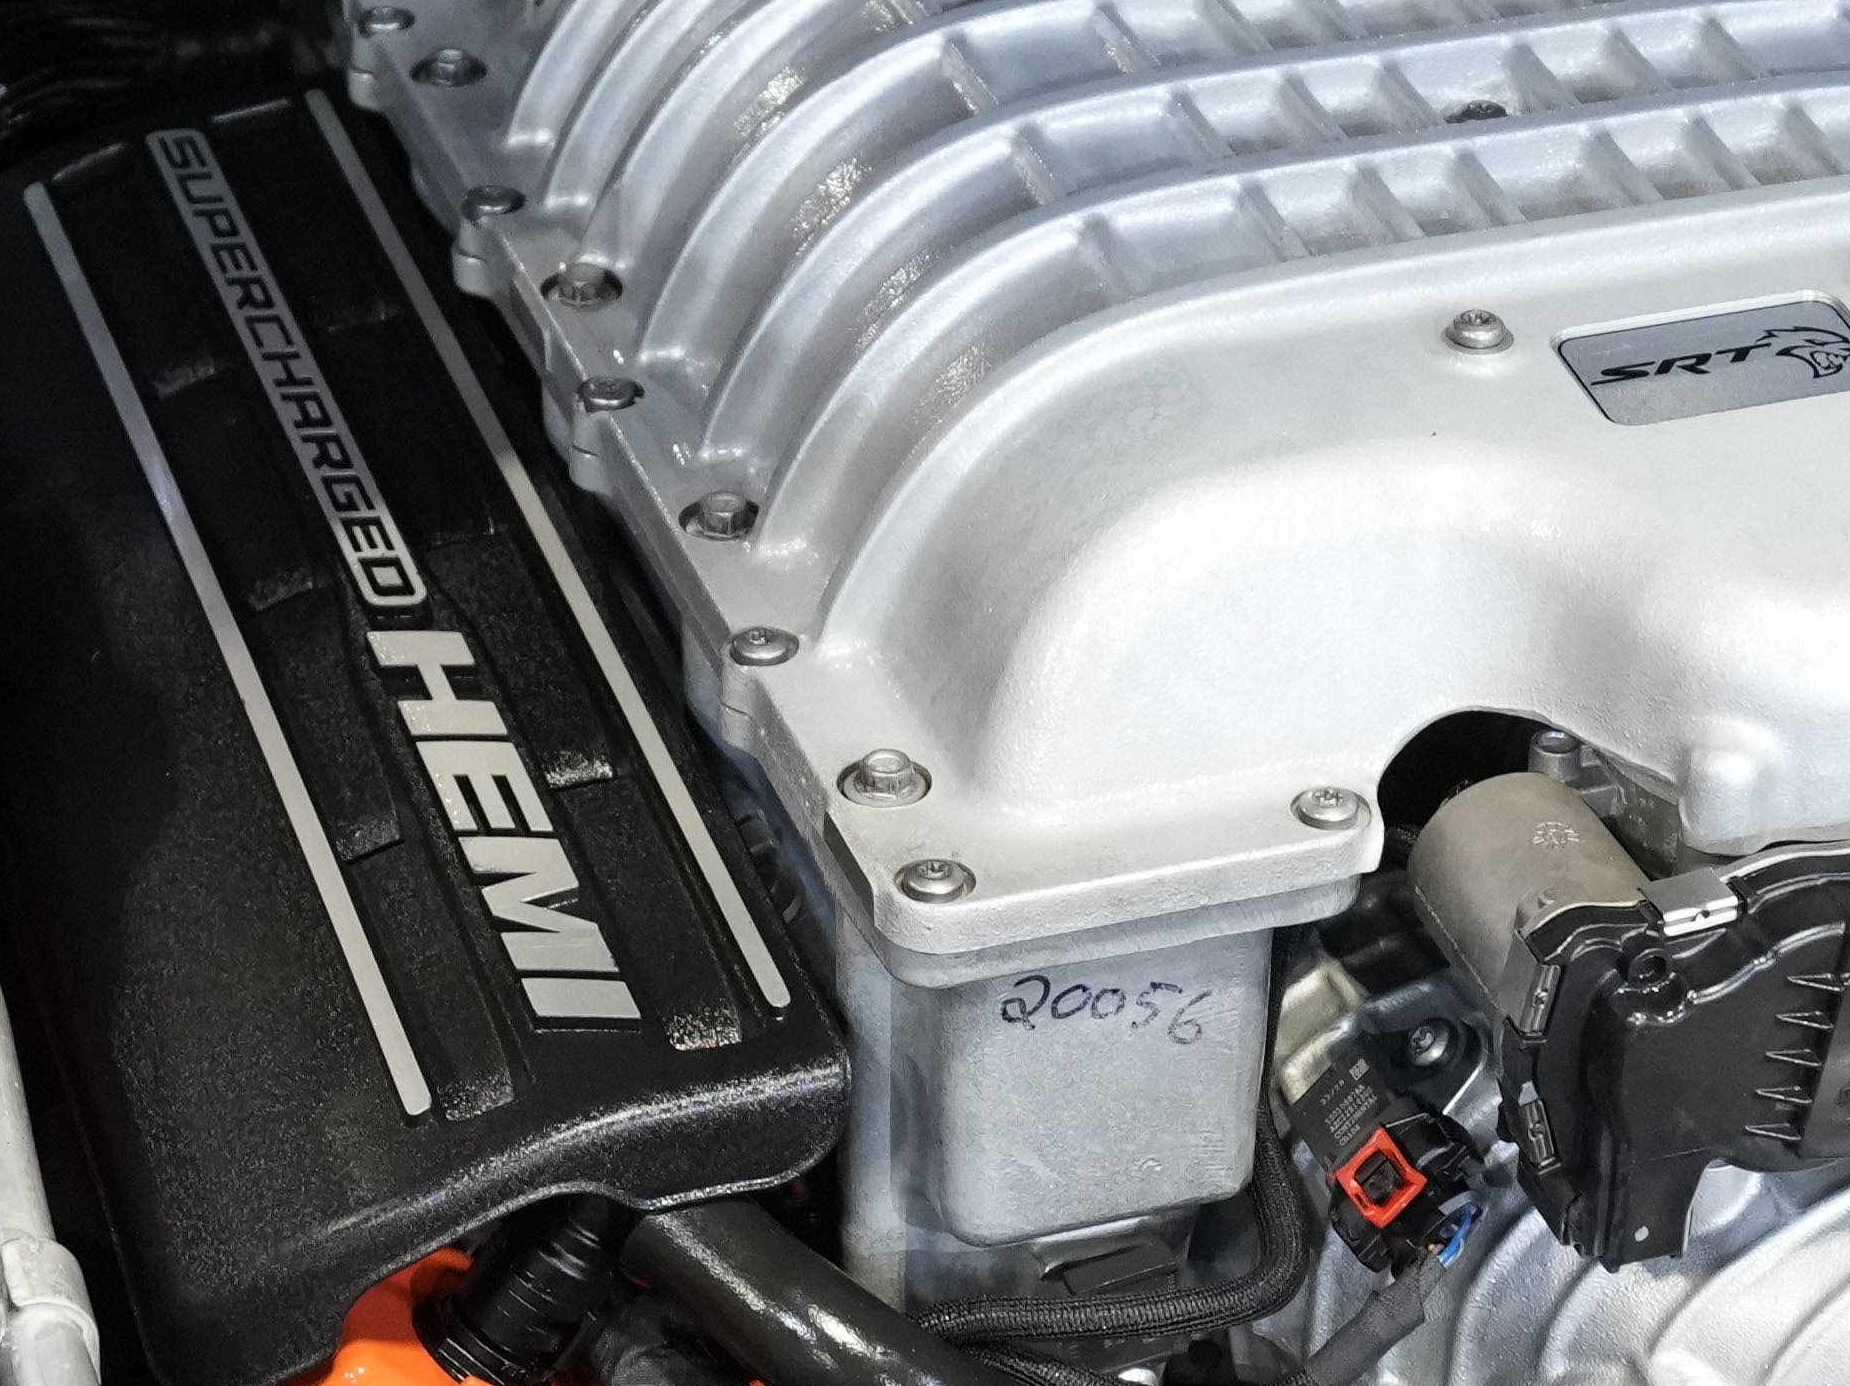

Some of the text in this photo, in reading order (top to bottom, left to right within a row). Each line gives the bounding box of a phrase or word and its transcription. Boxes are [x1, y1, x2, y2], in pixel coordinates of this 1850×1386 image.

[153, 132, 420, 600] SUPERCHARGED
[1590, 341, 1772, 387] SRT
[366, 628, 641, 1027] HEMI
[999, 974, 1213, 1046] 20056
